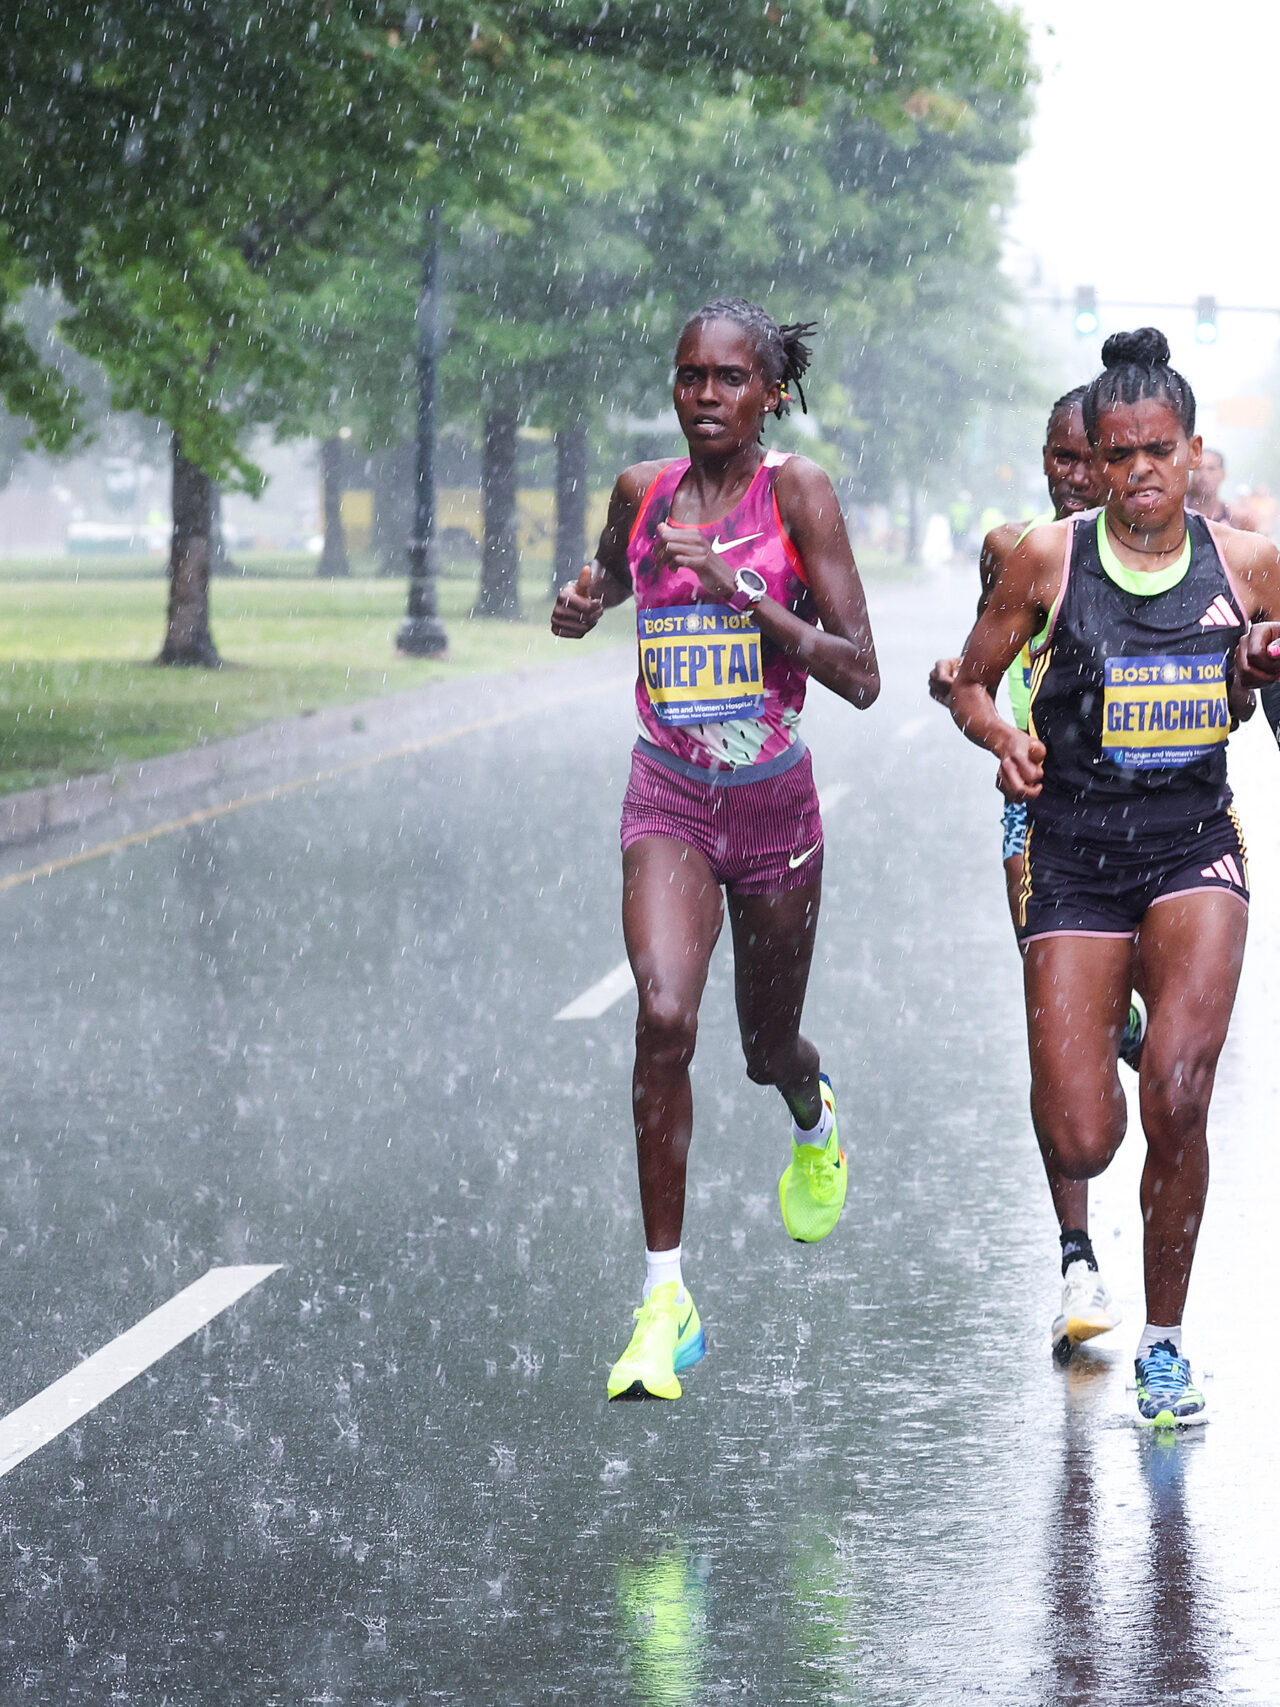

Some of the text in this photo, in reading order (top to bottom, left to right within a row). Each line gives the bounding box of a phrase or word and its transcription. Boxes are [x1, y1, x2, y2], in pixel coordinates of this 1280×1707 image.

[644, 614, 716, 634] BOSTON
[644, 643, 760, 690] CHEPTAI
[1111, 664, 1224, 683] BOSTON 10K
[680, 704, 694, 713] and
[695, 702, 725, 713] Women's
[1107, 697, 1228, 732] GETACHEW
[1124, 751, 1151, 760] Brigham
[1152, 750, 1164, 759] and
[1165, 749, 1193, 759] Women's
